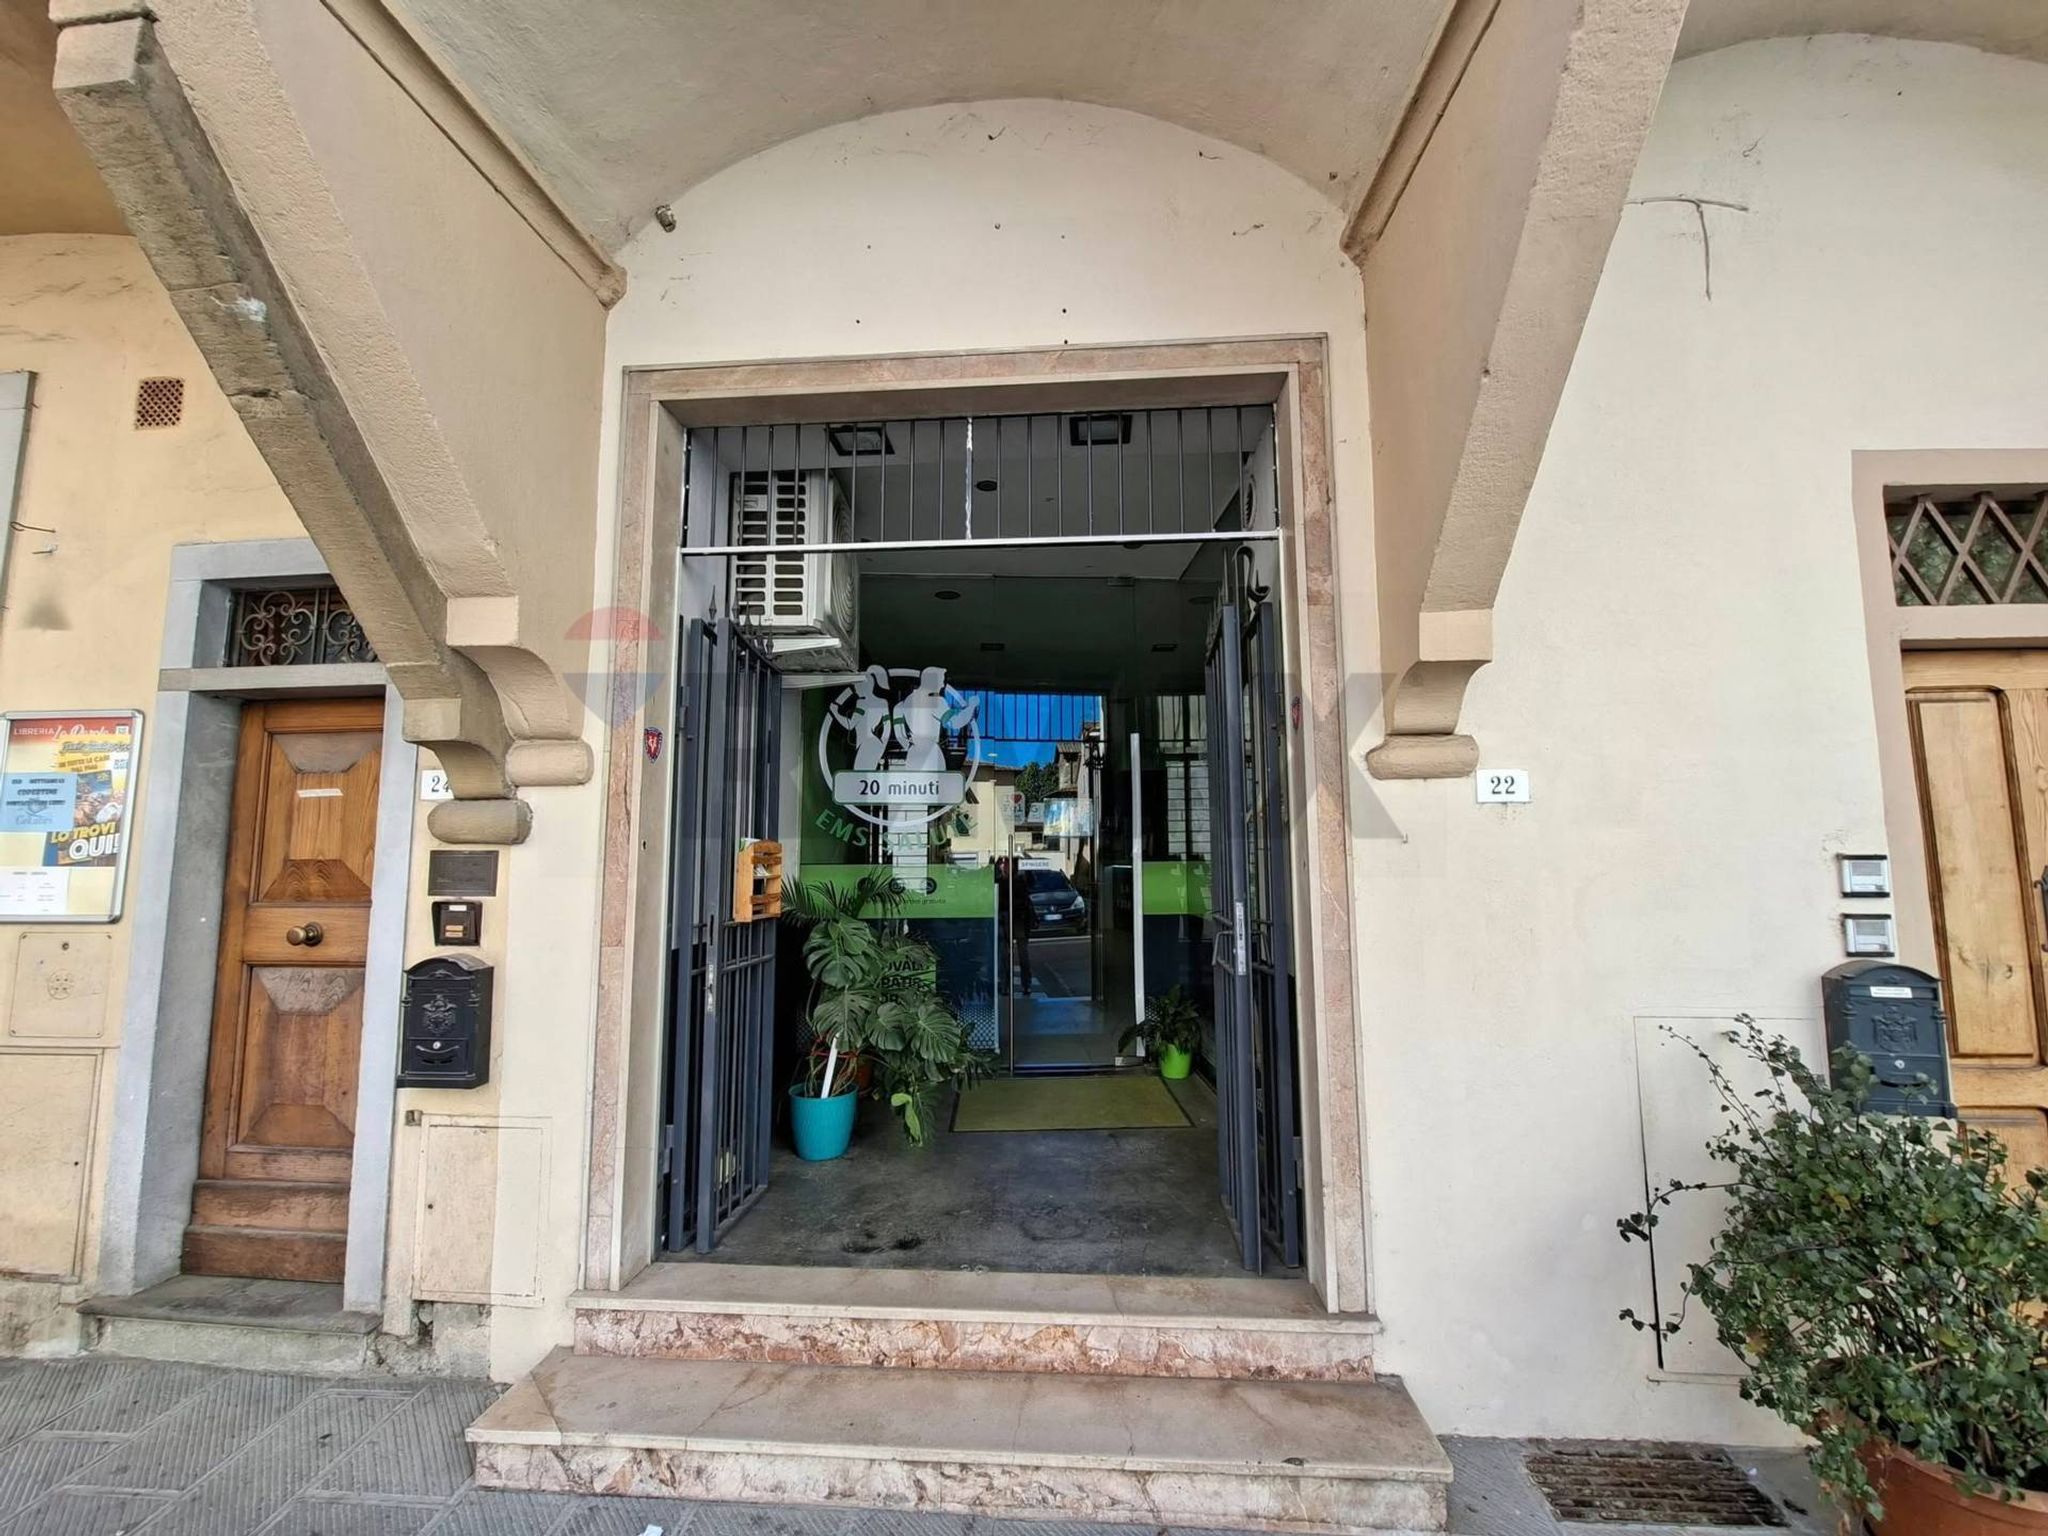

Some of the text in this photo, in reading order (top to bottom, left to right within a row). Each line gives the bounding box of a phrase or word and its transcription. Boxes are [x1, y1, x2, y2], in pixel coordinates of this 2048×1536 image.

[14, 727, 55, 736] LIBRERIA
[858, 777, 940, 797] 20 minuti
[1490, 776, 1516, 795] 22
[51, 821, 116, 843] LO TROVI
[814, 808, 979, 852] EMS SALUTE
[69, 833, 120, 860] QUI!
